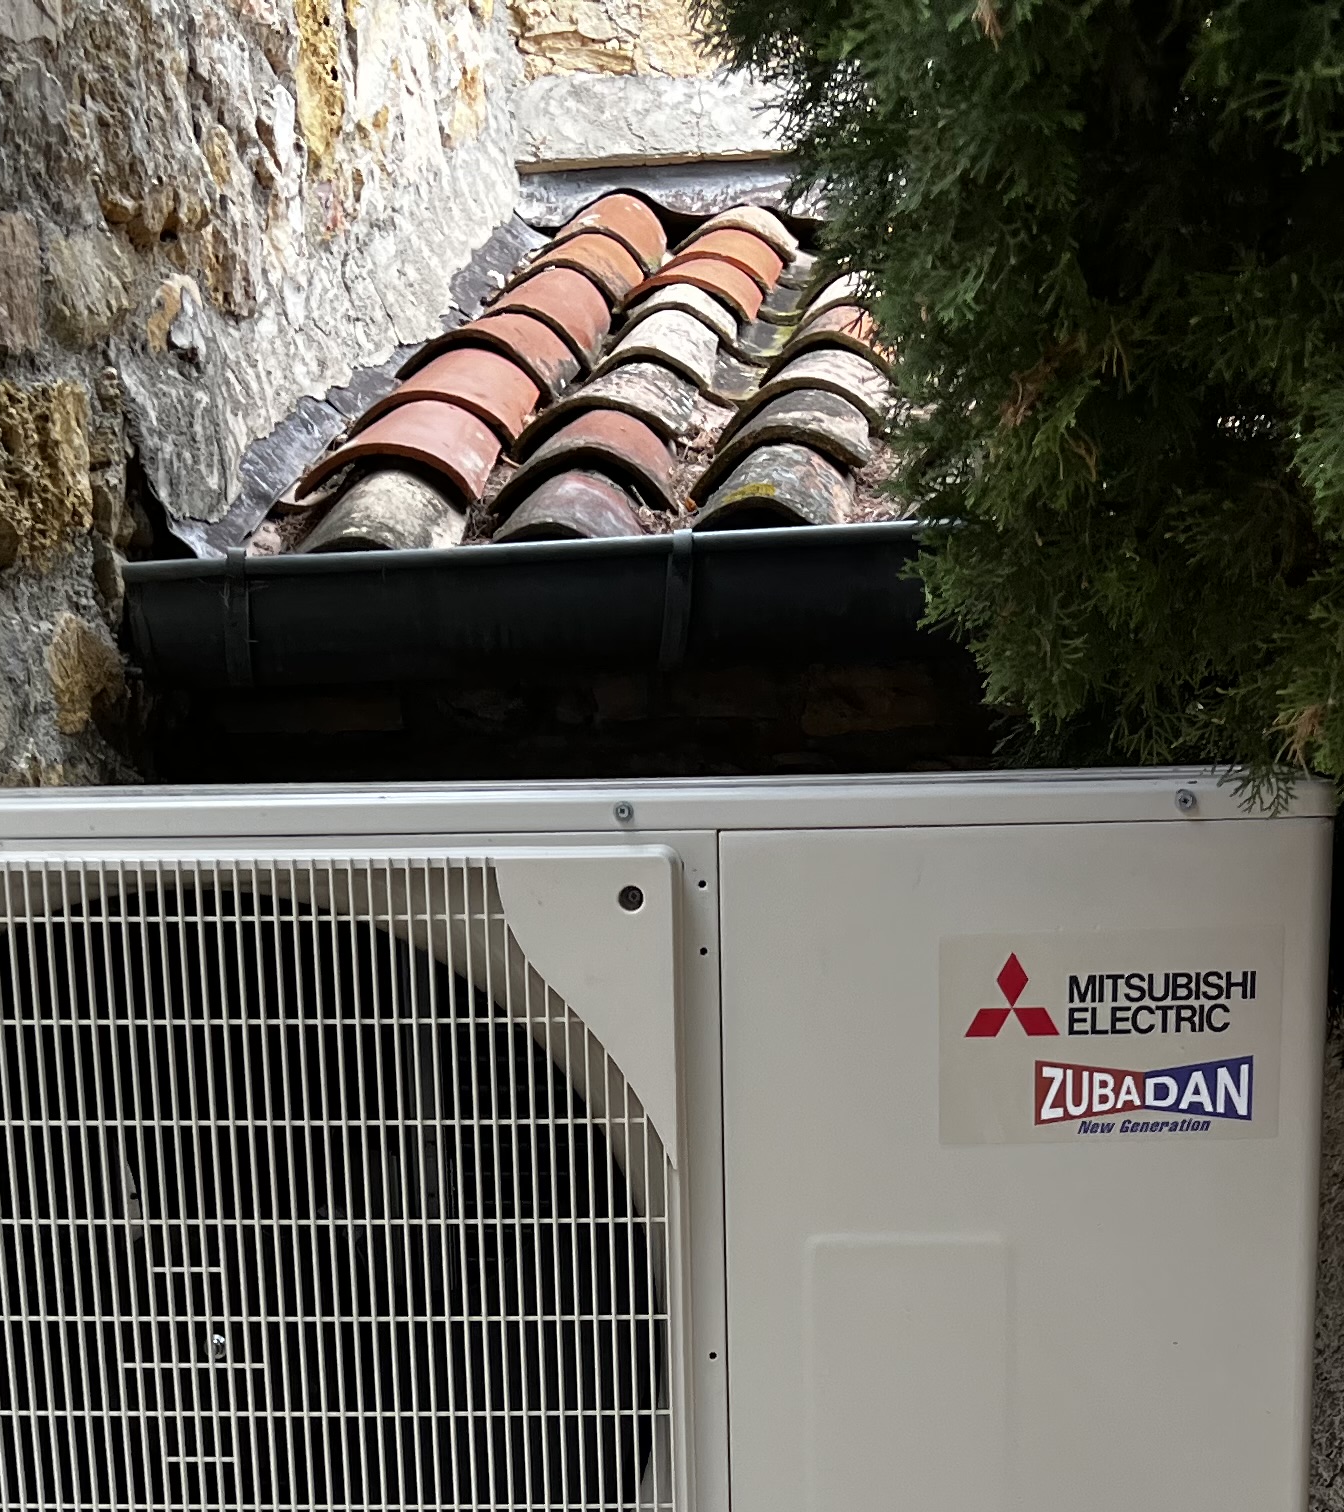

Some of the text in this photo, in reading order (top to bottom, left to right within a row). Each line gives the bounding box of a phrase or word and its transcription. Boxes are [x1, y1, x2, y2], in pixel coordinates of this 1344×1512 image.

[1068, 971, 1256, 1003] MITSUBISHI
[1068, 1004, 1230, 1035] ELECTRIC
[1040, 1063, 1250, 1121] ZUBADAN
[1077, 1118, 1211, 1134] New Generation
